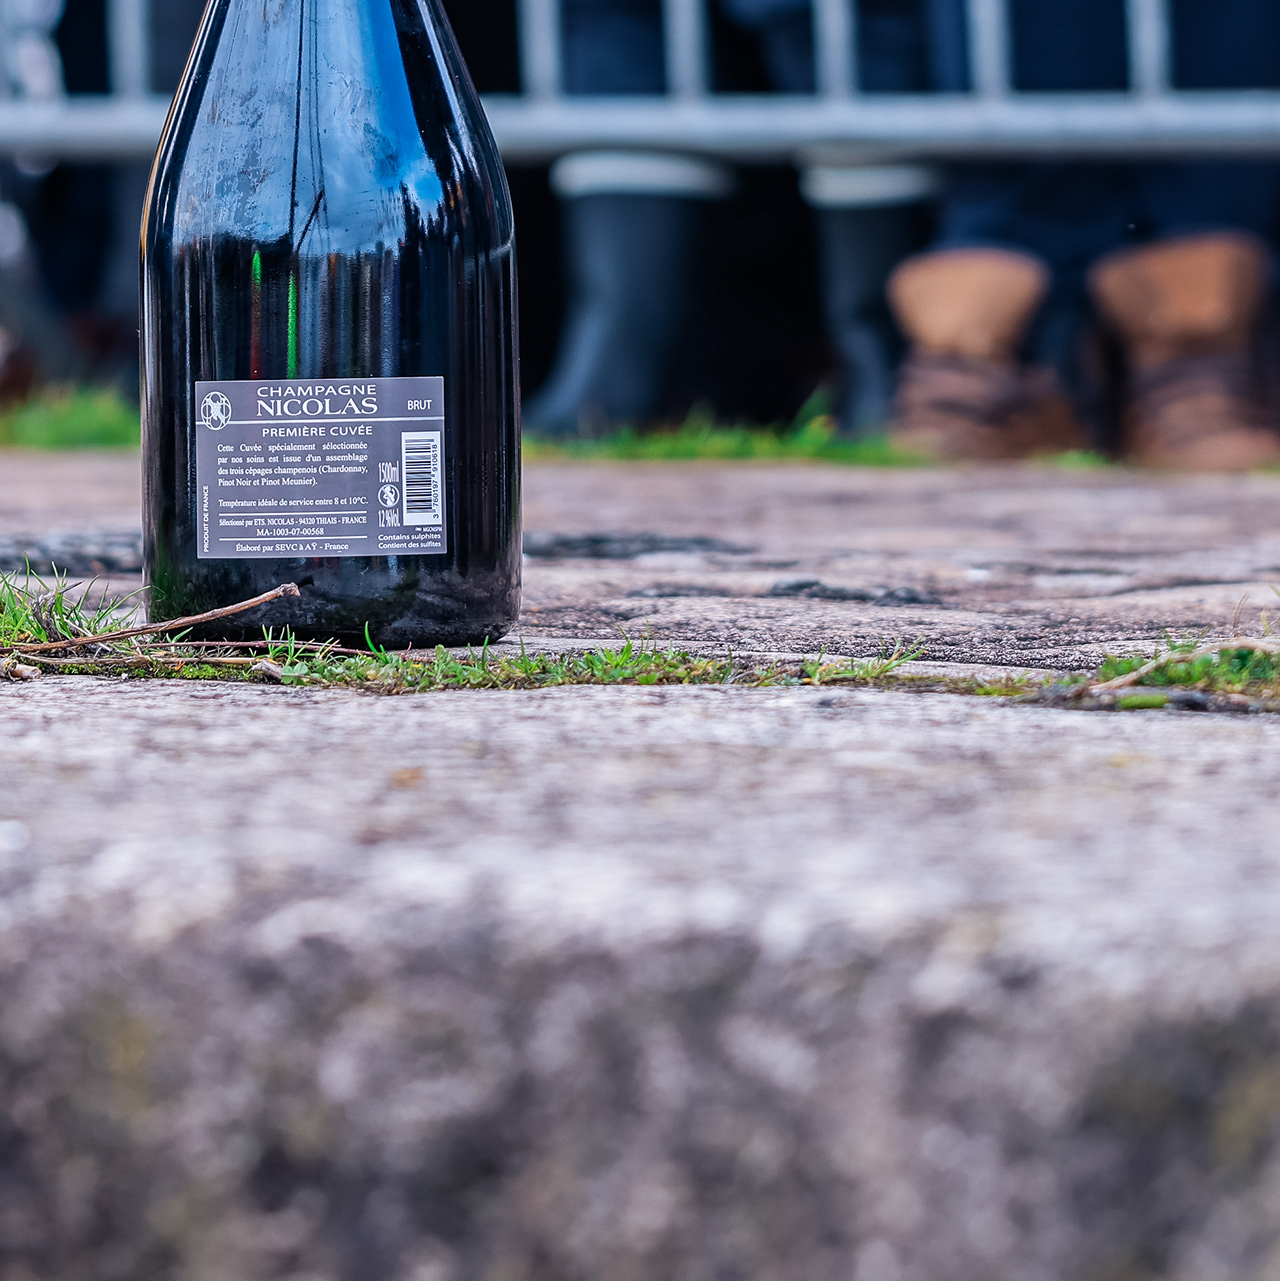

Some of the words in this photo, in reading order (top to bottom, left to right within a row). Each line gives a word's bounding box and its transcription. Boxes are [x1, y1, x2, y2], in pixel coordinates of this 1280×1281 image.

[256, 384, 377, 397] CHAMPAGNE
[256, 397, 378, 417] NICOLAS
[407, 399, 433, 410] BRUT
[262, 425, 326, 437] PREMIÈRE
[330, 424, 373, 436] CUVÉE
[217, 443, 234, 452] Cette
[239, 443, 262, 452] Cuvée
[268, 442, 316, 453] spécialement
[322, 441, 368, 451] sélectionnée
[217, 456, 228, 465] par
[246, 455, 265, 463] soins
[268, 455, 279, 463] est
[283, 454, 302, 462] issue
[305, 454, 322, 462] d'un
[325, 453, 368, 462] assemblage
[217, 467, 228, 475] des
[229, 466, 244, 475] trois
[244, 466, 273, 476] cépages
[273, 465, 317, 476] champenois
[318, 464, 368, 475] (Chardonnay,
[378, 460, 399, 483] 1500ml
[218, 478, 235, 486] Pinot
[236, 477, 251, 486] Noir
[252, 478, 260, 486] et
[261, 477, 280, 486] Pinot
[281, 476, 318, 486] Meunier).
[218, 499, 257, 508] Température
[257, 498, 278, 506] idéale
[278, 498, 288, 506] de
[288, 498, 314, 506] service
[314, 498, 333, 506] entre
[334, 497, 339, 505] 8
[203, 512, 209, 522] DE
[245, 519, 253, 527] par
[254, 518, 266, 526] ETS.
[267, 518, 294, 526] NICOLAS
[298, 517, 315, 525] 94320
[316, 517, 337, 525] THIAIS
[341, 516, 367, 524] FRANCE
[256, 527, 324, 536] MA-1003-07-00568
[411, 533, 441, 541] sulphites
[236, 543, 261, 552] Élaboré
[262, 545, 273, 553] par
[275, 543, 298, 551] SEVC
[299, 543, 304, 551] à
[324, 542, 349, 550] France
[420, 540, 441, 548] sulfites
